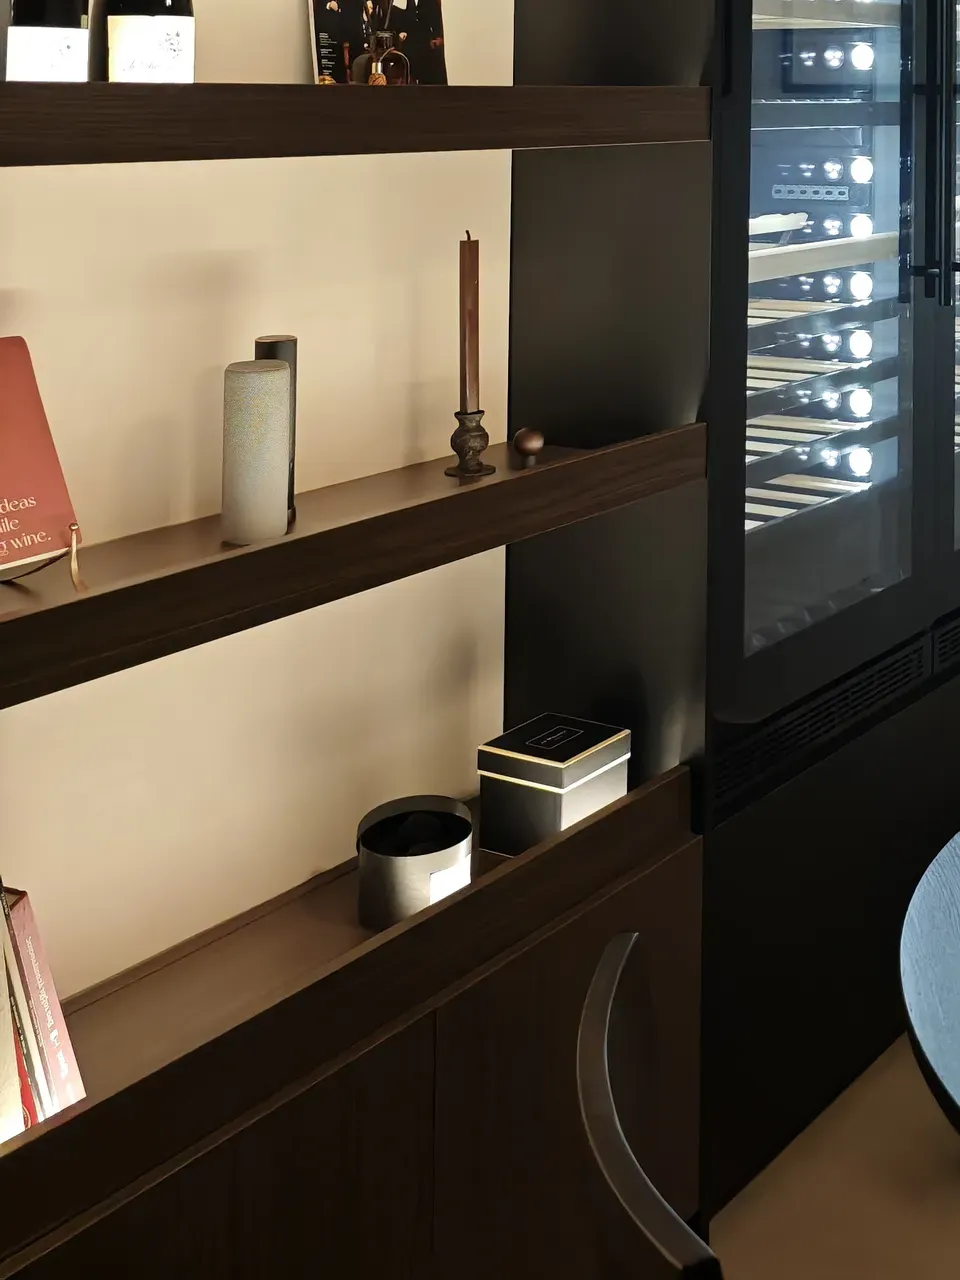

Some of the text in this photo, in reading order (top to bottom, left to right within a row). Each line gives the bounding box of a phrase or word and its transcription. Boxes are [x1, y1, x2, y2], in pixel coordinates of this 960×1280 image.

[0, 497, 36, 514] deas
[0, 517, 20, 532] ile
[10, 532, 51, 548] wine.
